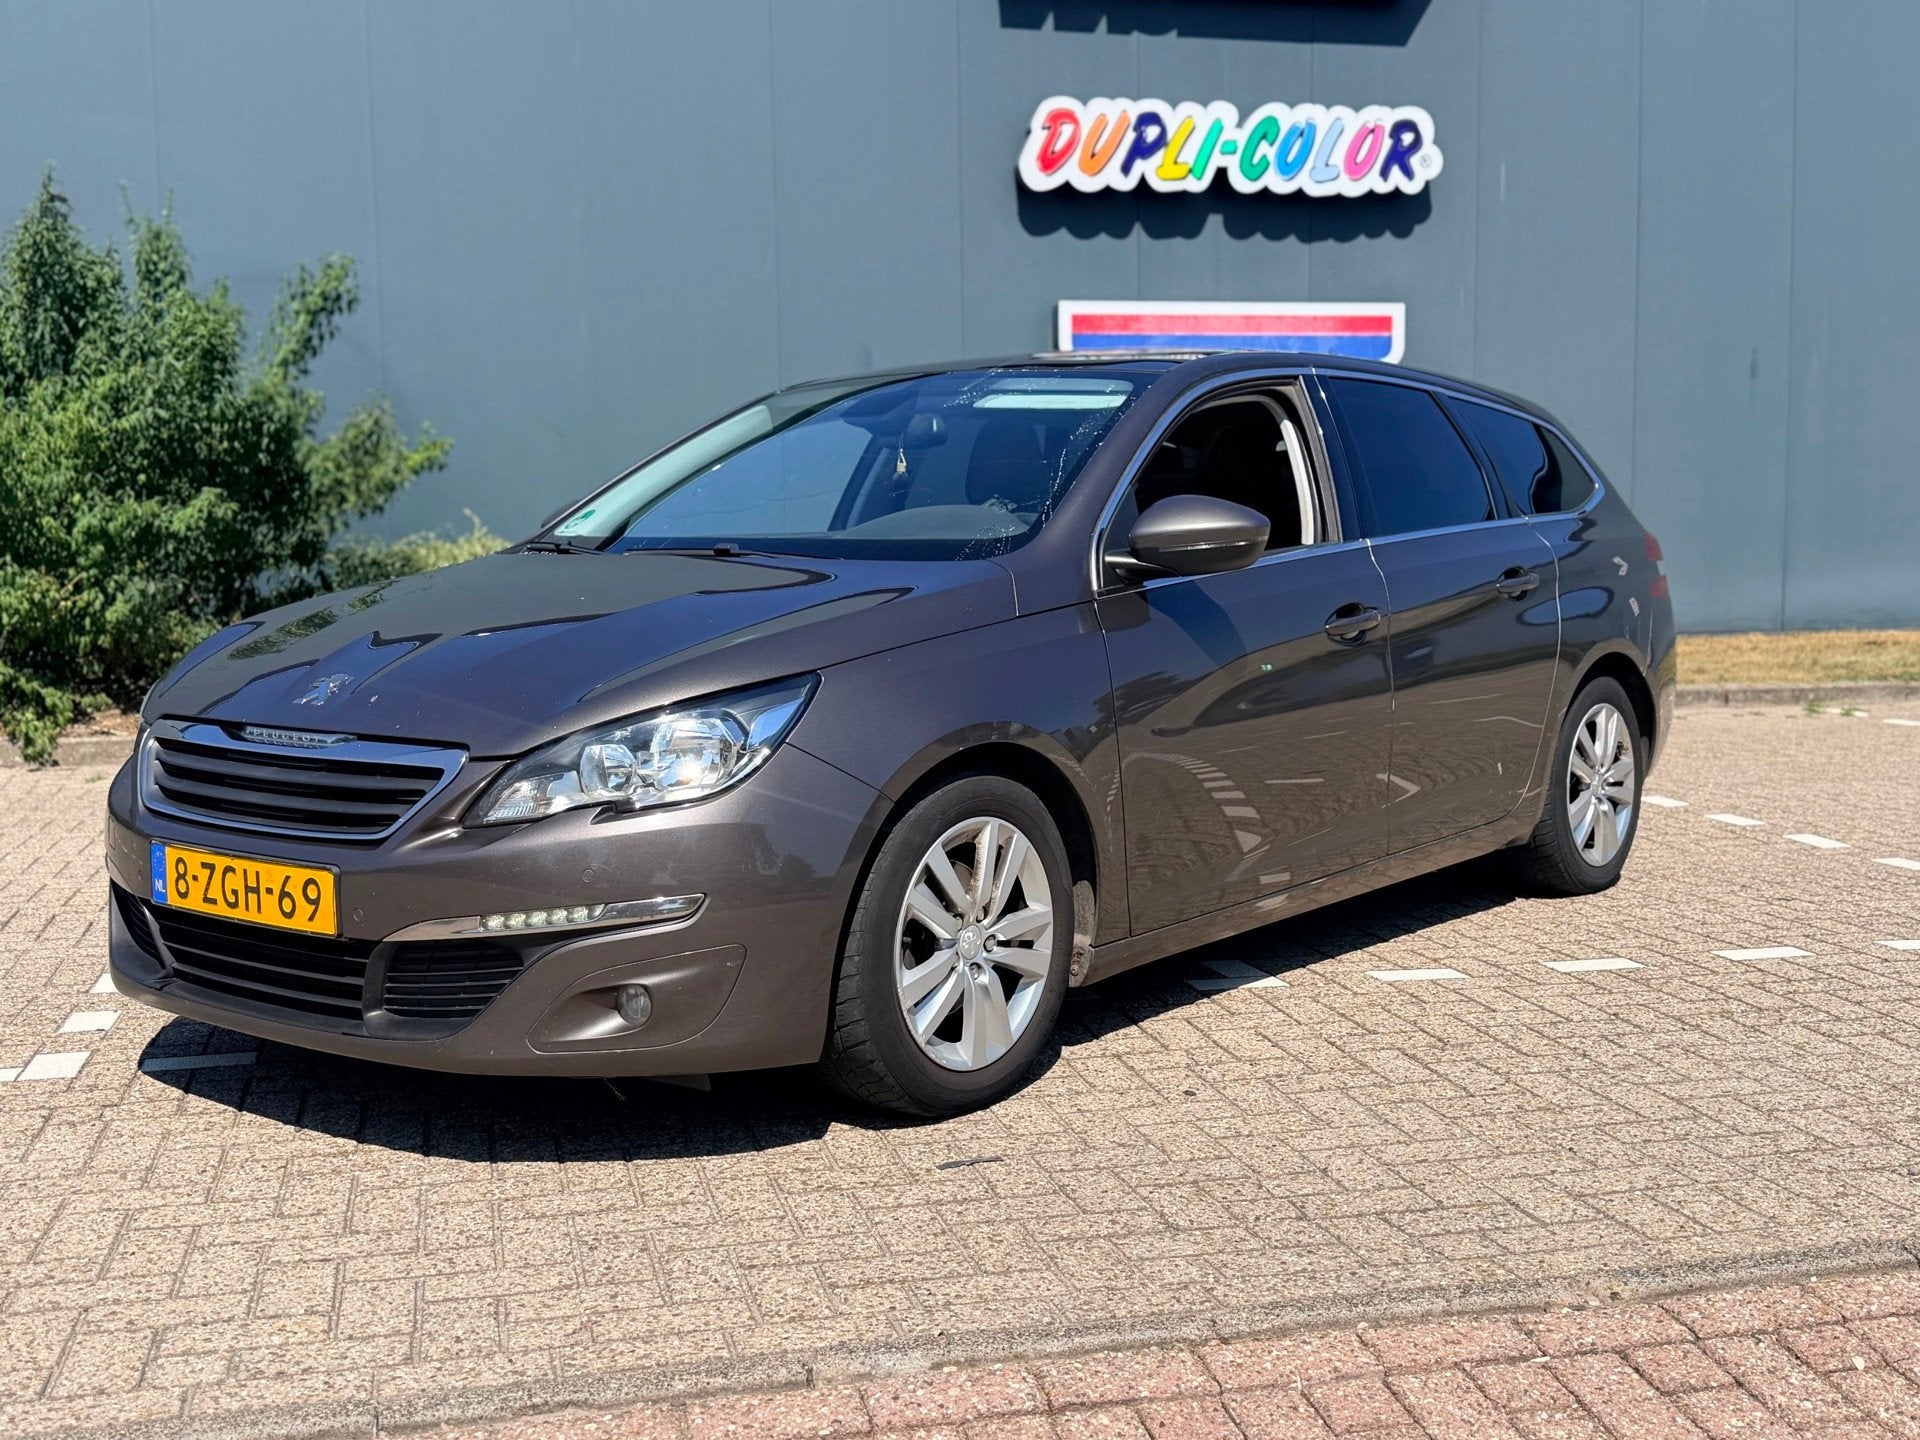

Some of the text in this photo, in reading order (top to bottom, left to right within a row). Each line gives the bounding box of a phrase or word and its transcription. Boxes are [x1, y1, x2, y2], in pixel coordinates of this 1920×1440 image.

[1037, 108, 1423, 183] DUPLI-COLOR
[253, 728, 320, 743] PEUGEOT
[154, 878, 166, 893] NL
[174, 856, 322, 922] 8-ZGH-69
